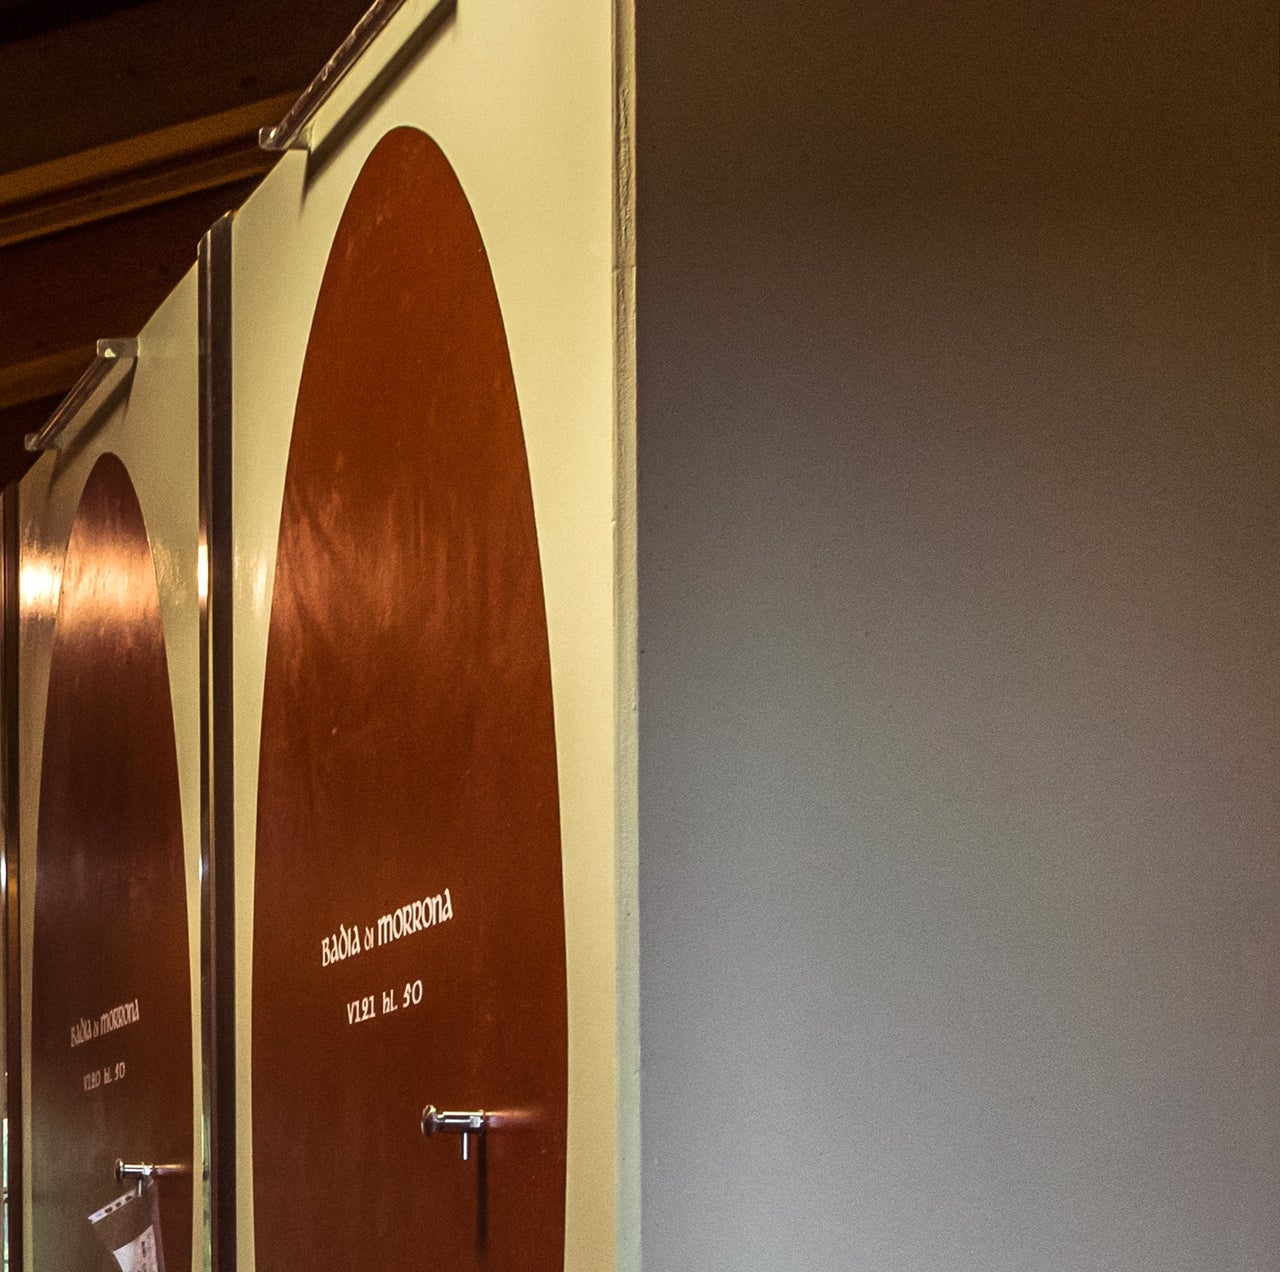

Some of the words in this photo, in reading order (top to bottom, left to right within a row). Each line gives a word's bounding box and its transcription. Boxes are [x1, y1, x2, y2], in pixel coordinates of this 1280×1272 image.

[321, 923, 361, 967] Badia
[377, 888, 453, 947] Morrona
[346, 995, 376, 1025] V121
[403, 979, 423, 1008] 50
